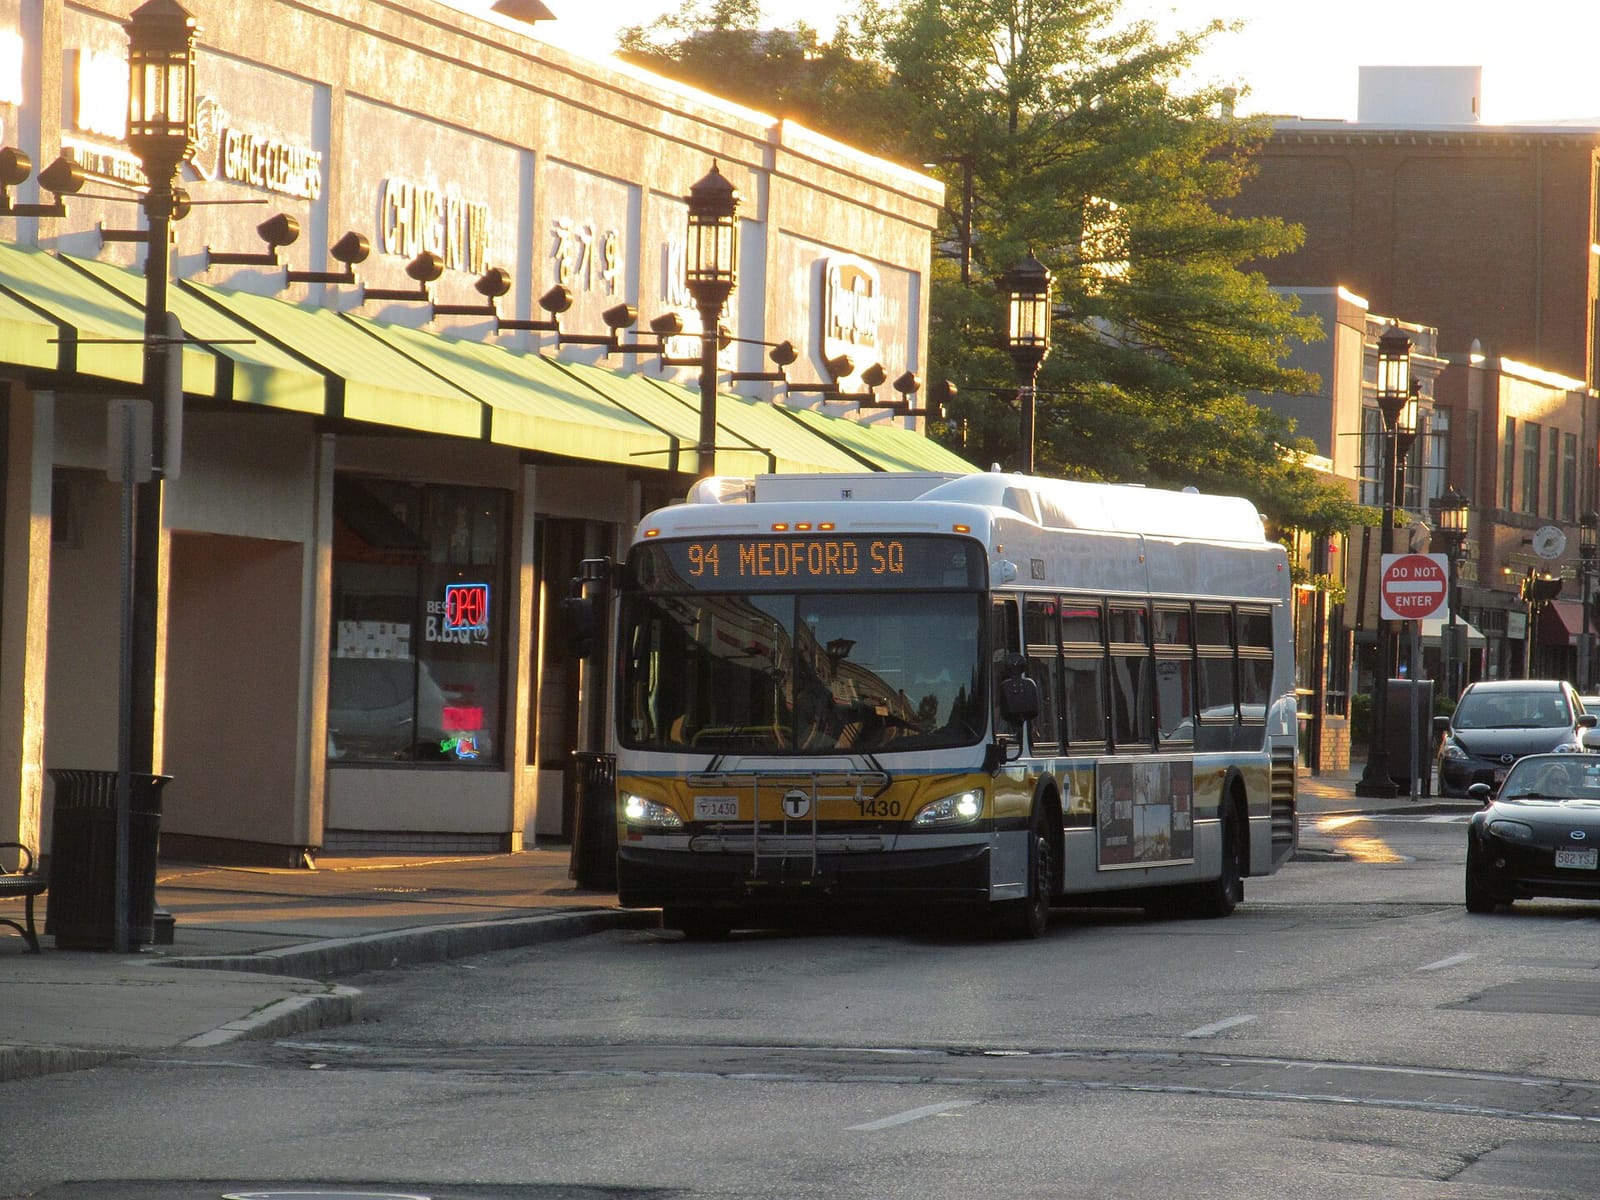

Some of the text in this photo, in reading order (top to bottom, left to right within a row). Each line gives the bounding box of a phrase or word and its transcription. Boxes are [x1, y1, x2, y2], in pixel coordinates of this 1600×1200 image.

[224, 128, 265, 187] GRACE
[384, 176, 443, 260] CHUNG
[688, 541, 904, 576] 94 MEDFORD SQ
[1392, 567, 1437, 578] DO NOT
[426, 600, 457, 615] BEST
[447, 588, 486, 625] OPEN
[1395, 595, 1433, 607] ENTER
[711, 803, 737, 816] 1430
[786, 796, 805, 814] T
[859, 800, 900, 817] 1430
